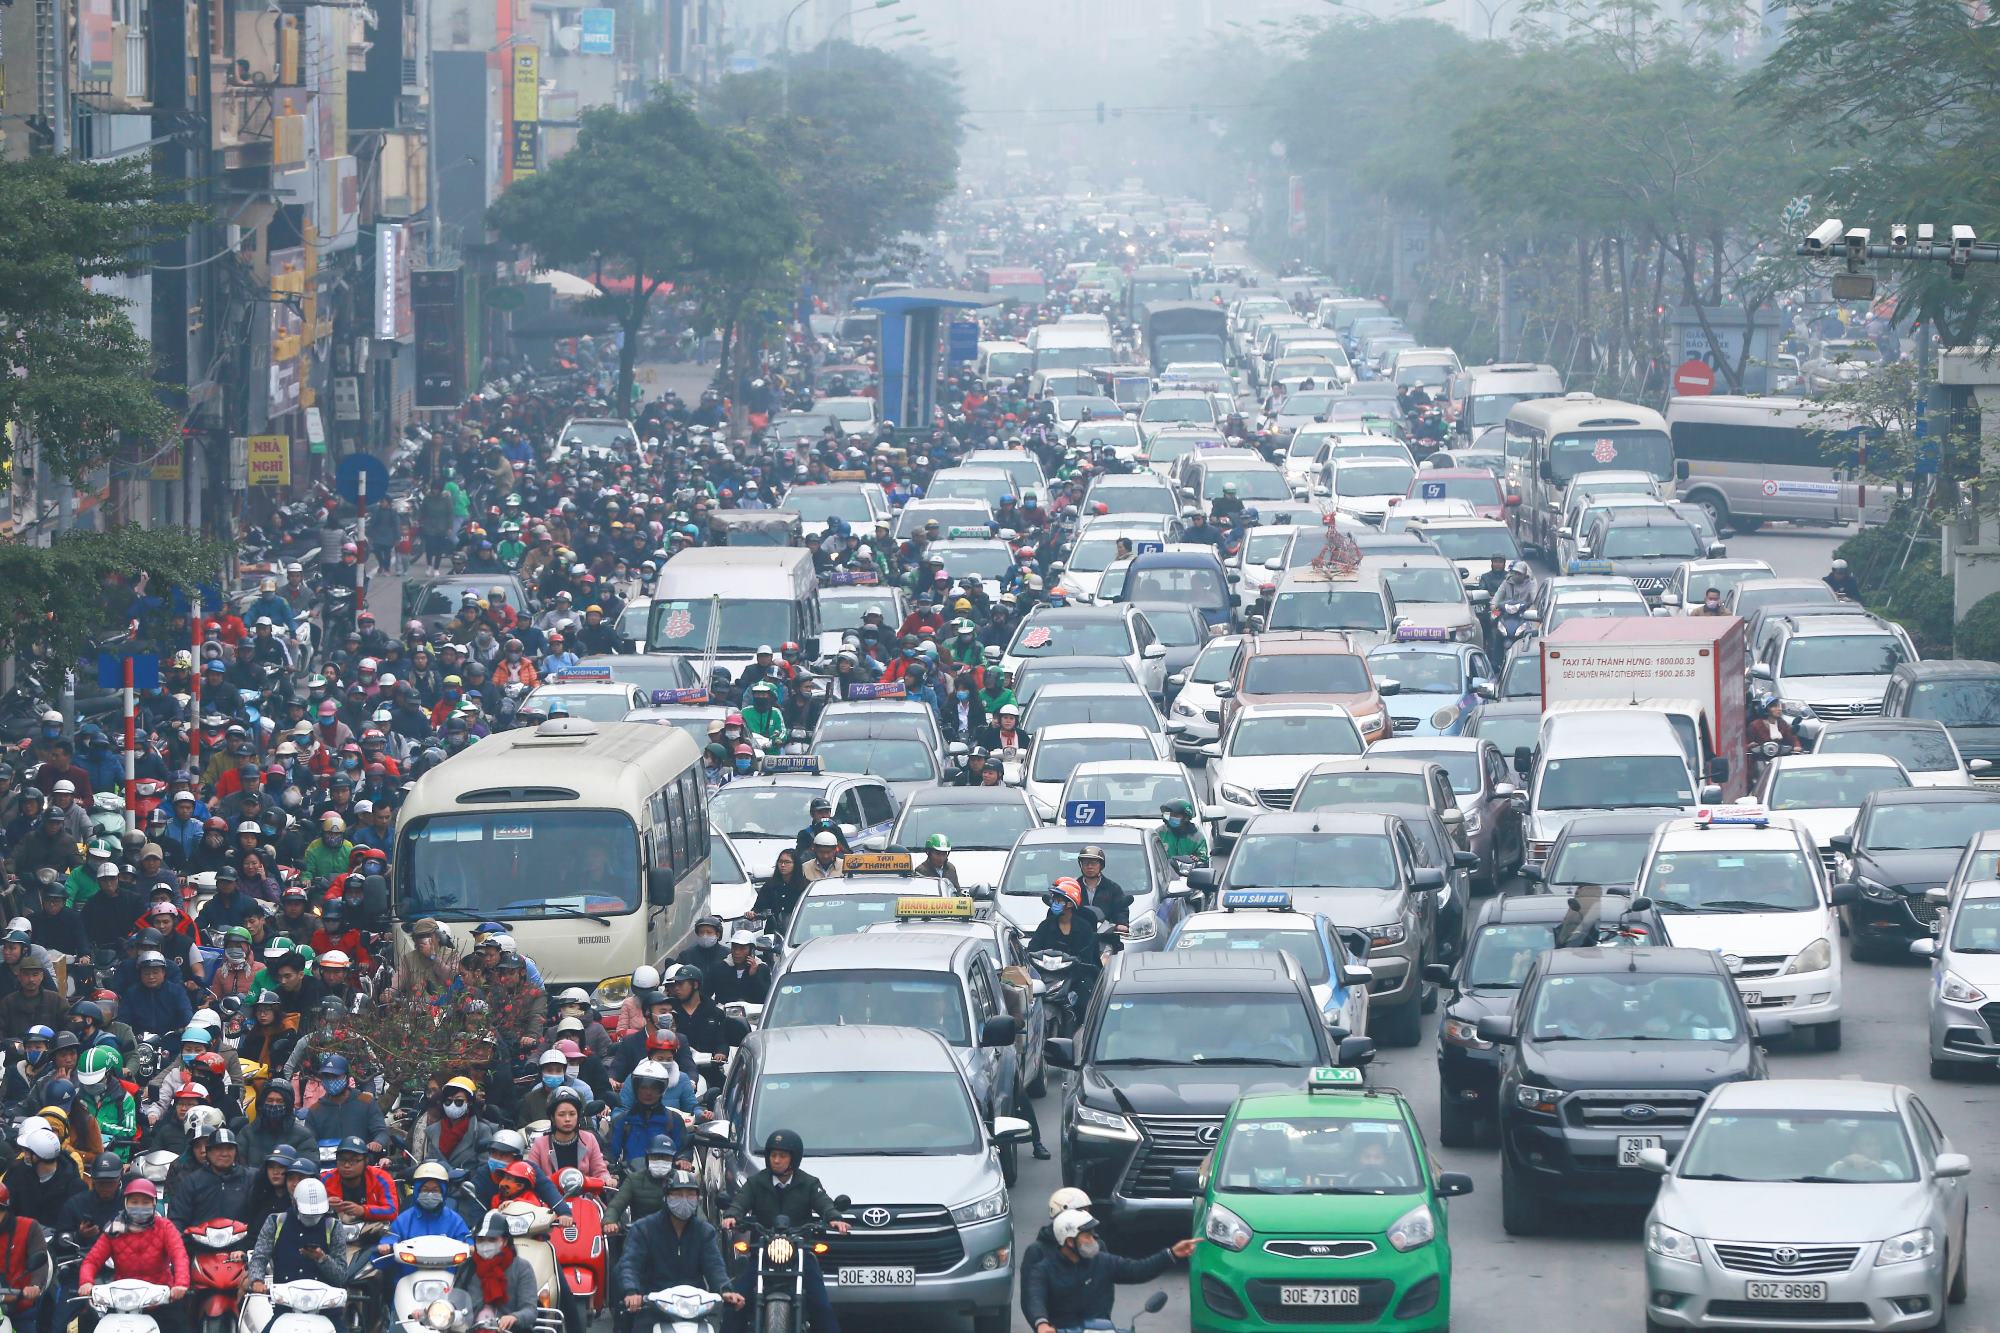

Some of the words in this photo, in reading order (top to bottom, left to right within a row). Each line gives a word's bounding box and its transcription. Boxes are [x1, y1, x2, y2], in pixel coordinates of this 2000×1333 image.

[1562, 658, 1580, 666] TAXI
[1075, 803, 1096, 824] G7
[1228, 894, 1246, 904] TAXI
[1266, 894, 1285, 904] BAY
[577, 935, 611, 944] INTERCOOLER
[1317, 1069, 1355, 1080] TAXI
[840, 1269, 914, 1285] 30E-384.83
[1283, 1288, 1358, 1304] 30E-731.06
[1751, 1284, 1821, 1299] 30Z-9698
